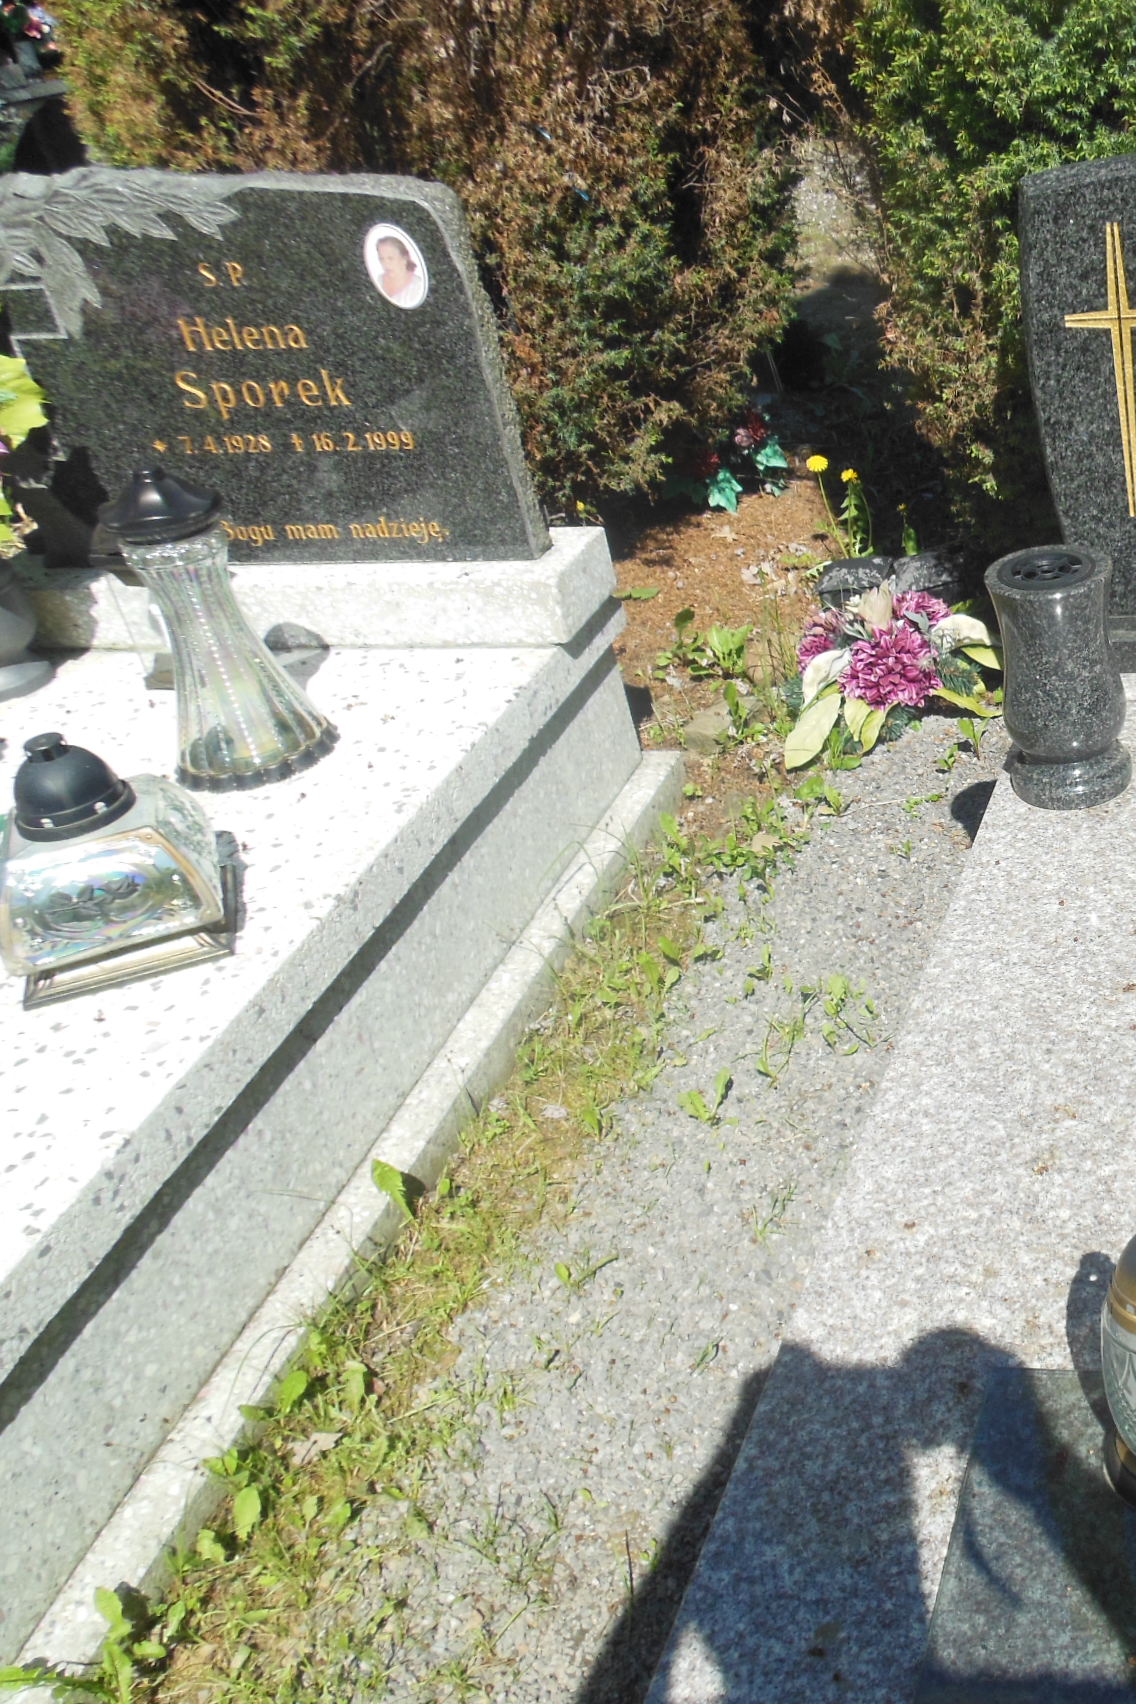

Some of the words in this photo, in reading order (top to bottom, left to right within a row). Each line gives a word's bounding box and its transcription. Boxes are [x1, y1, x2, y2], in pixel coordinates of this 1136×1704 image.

[177, 316, 310, 352] Helena
[174, 368, 353, 420] Sporek
[285, 522, 341, 541] mam
